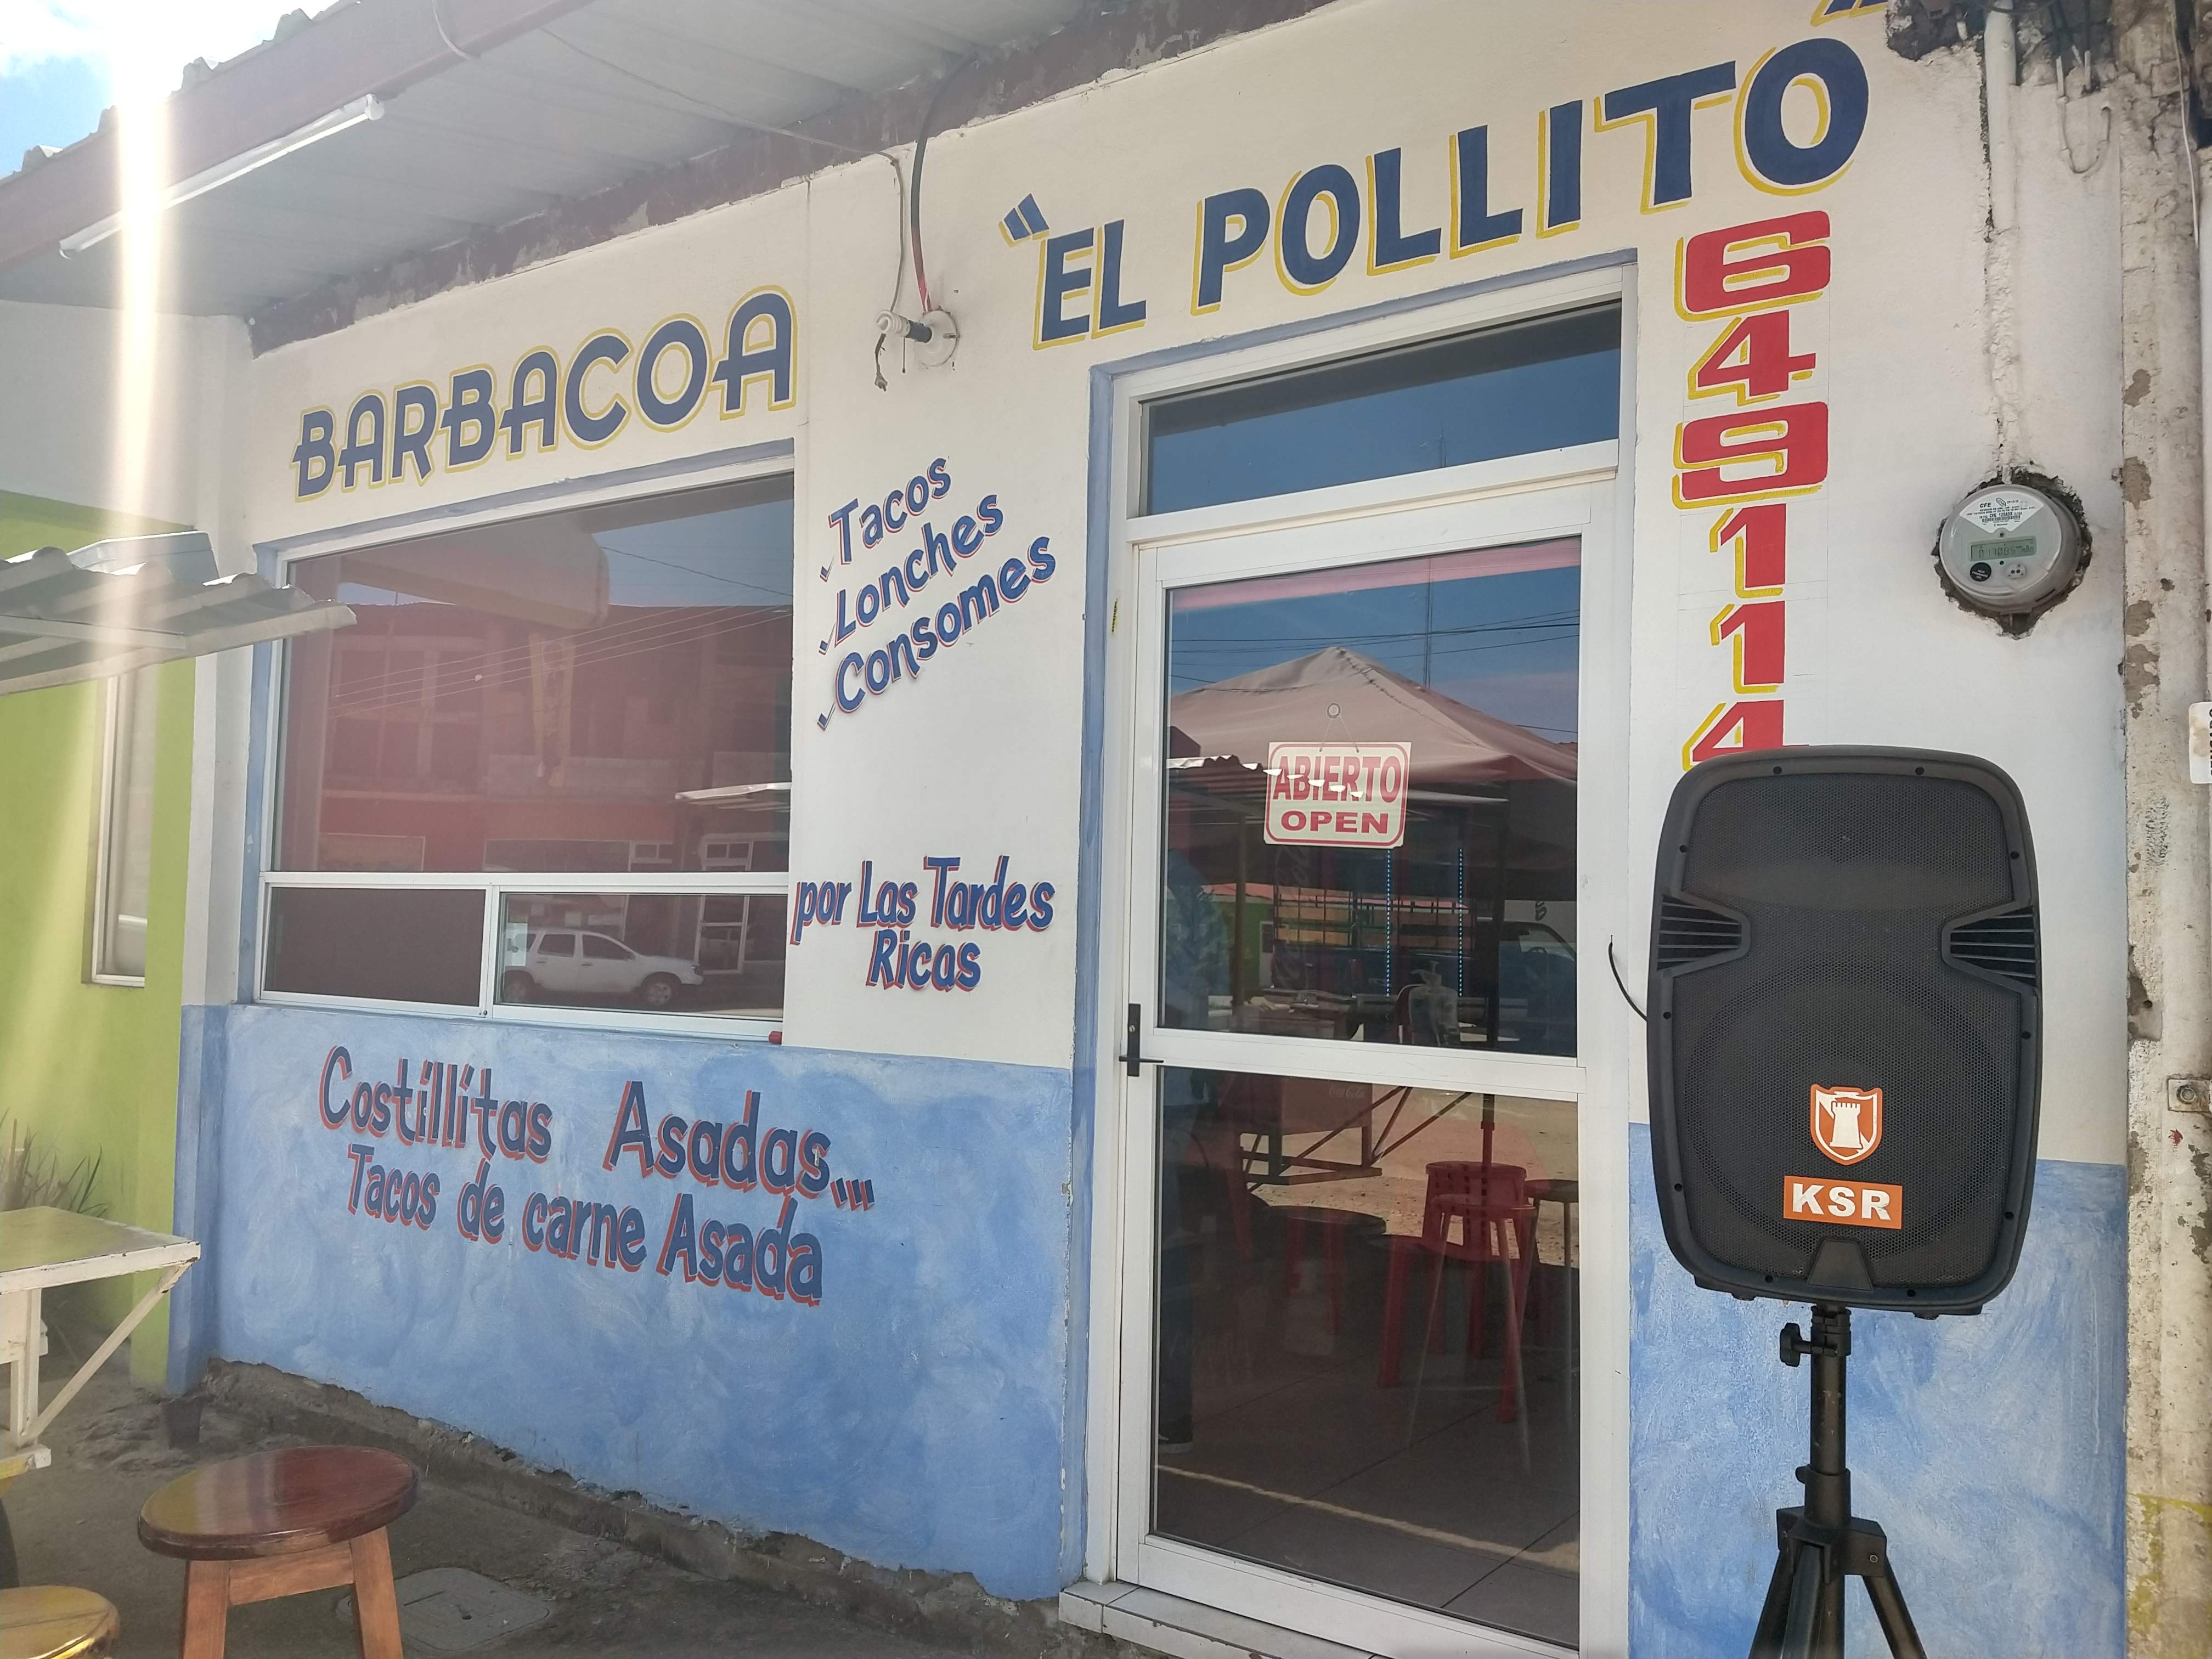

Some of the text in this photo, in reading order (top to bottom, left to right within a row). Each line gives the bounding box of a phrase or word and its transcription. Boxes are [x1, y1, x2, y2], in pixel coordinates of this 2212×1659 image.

[292, 284, 798, 502] BARBACOA
[828, 458, 951, 565] Tacos
[834, 494, 1003, 647] Lonches
[835, 537, 1056, 713] Consomes
[1272, 755, 1402, 804] ABIERTO
[1280, 810, 1389, 834] OPEN
[790, 855, 1055, 945] por Las Tardes
[866, 929, 981, 992] Ricas
[347, 1143, 822, 1306] Tacos de carne Asada
[1792, 1183, 1892, 1221] KSR
